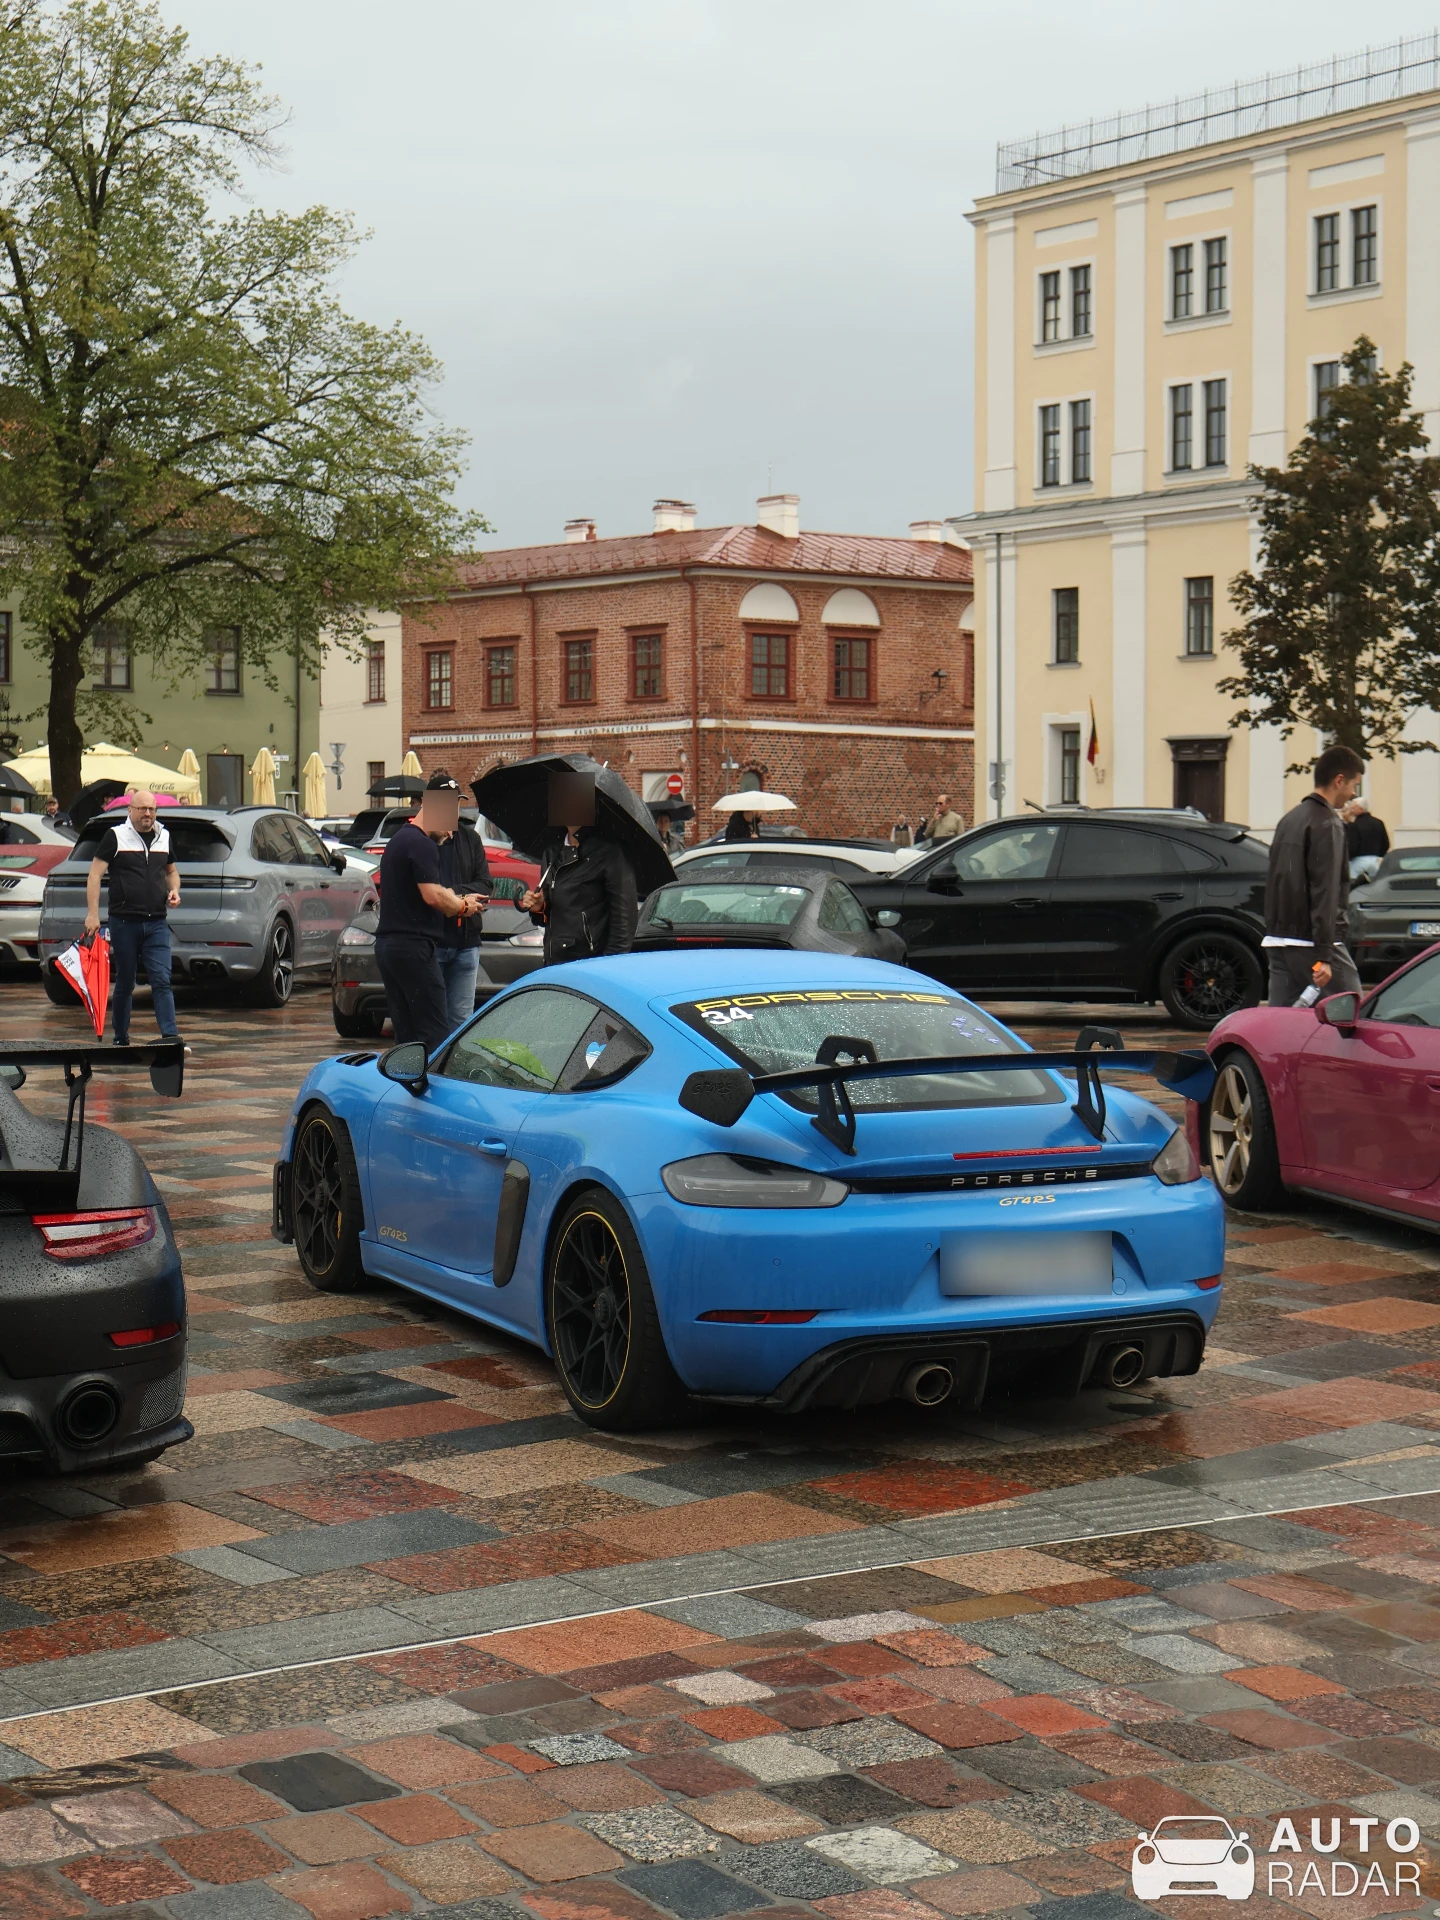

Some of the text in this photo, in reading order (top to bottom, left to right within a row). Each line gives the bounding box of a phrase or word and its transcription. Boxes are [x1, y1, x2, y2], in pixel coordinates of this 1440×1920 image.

[694, 992, 950, 1012] PORSCHE
[701, 1007, 755, 1025] 34
[951, 1169, 1098, 1187] PORSCHE
[999, 1195, 1056, 1206] GT4RS
[380, 1226, 408, 1242] GT4RS
